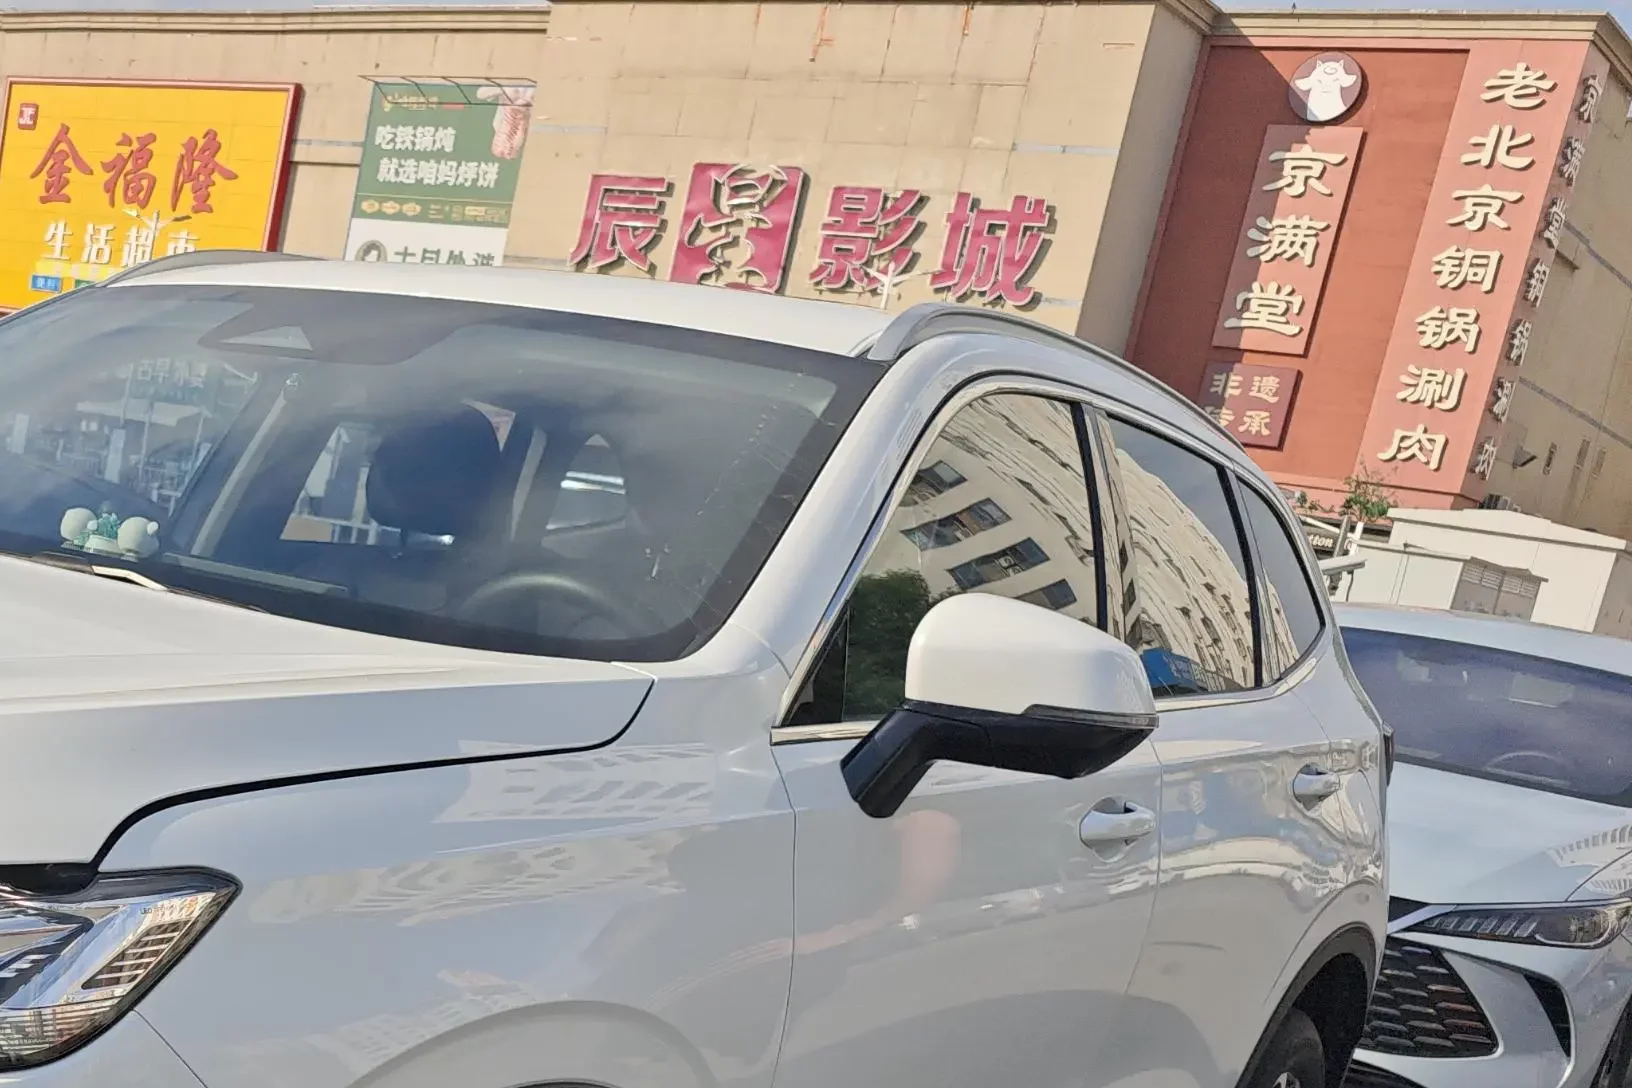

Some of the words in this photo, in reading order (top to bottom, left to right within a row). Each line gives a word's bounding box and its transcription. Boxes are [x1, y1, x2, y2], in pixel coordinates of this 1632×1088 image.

[29, 123, 239, 214] 金福隆
[375, 125, 456, 153] 吃铁锅炖
[377, 157, 500, 189] 就选咱妈烀饼
[39, 220, 200, 268] 生活超市
[569, 163, 1052, 306] 辰星影城
[1224, 143, 1349, 338] 京满堂
[1377, 62, 1557, 471] 老北京铜锅涮肉
[1210, 372, 1280, 403] 非遗
